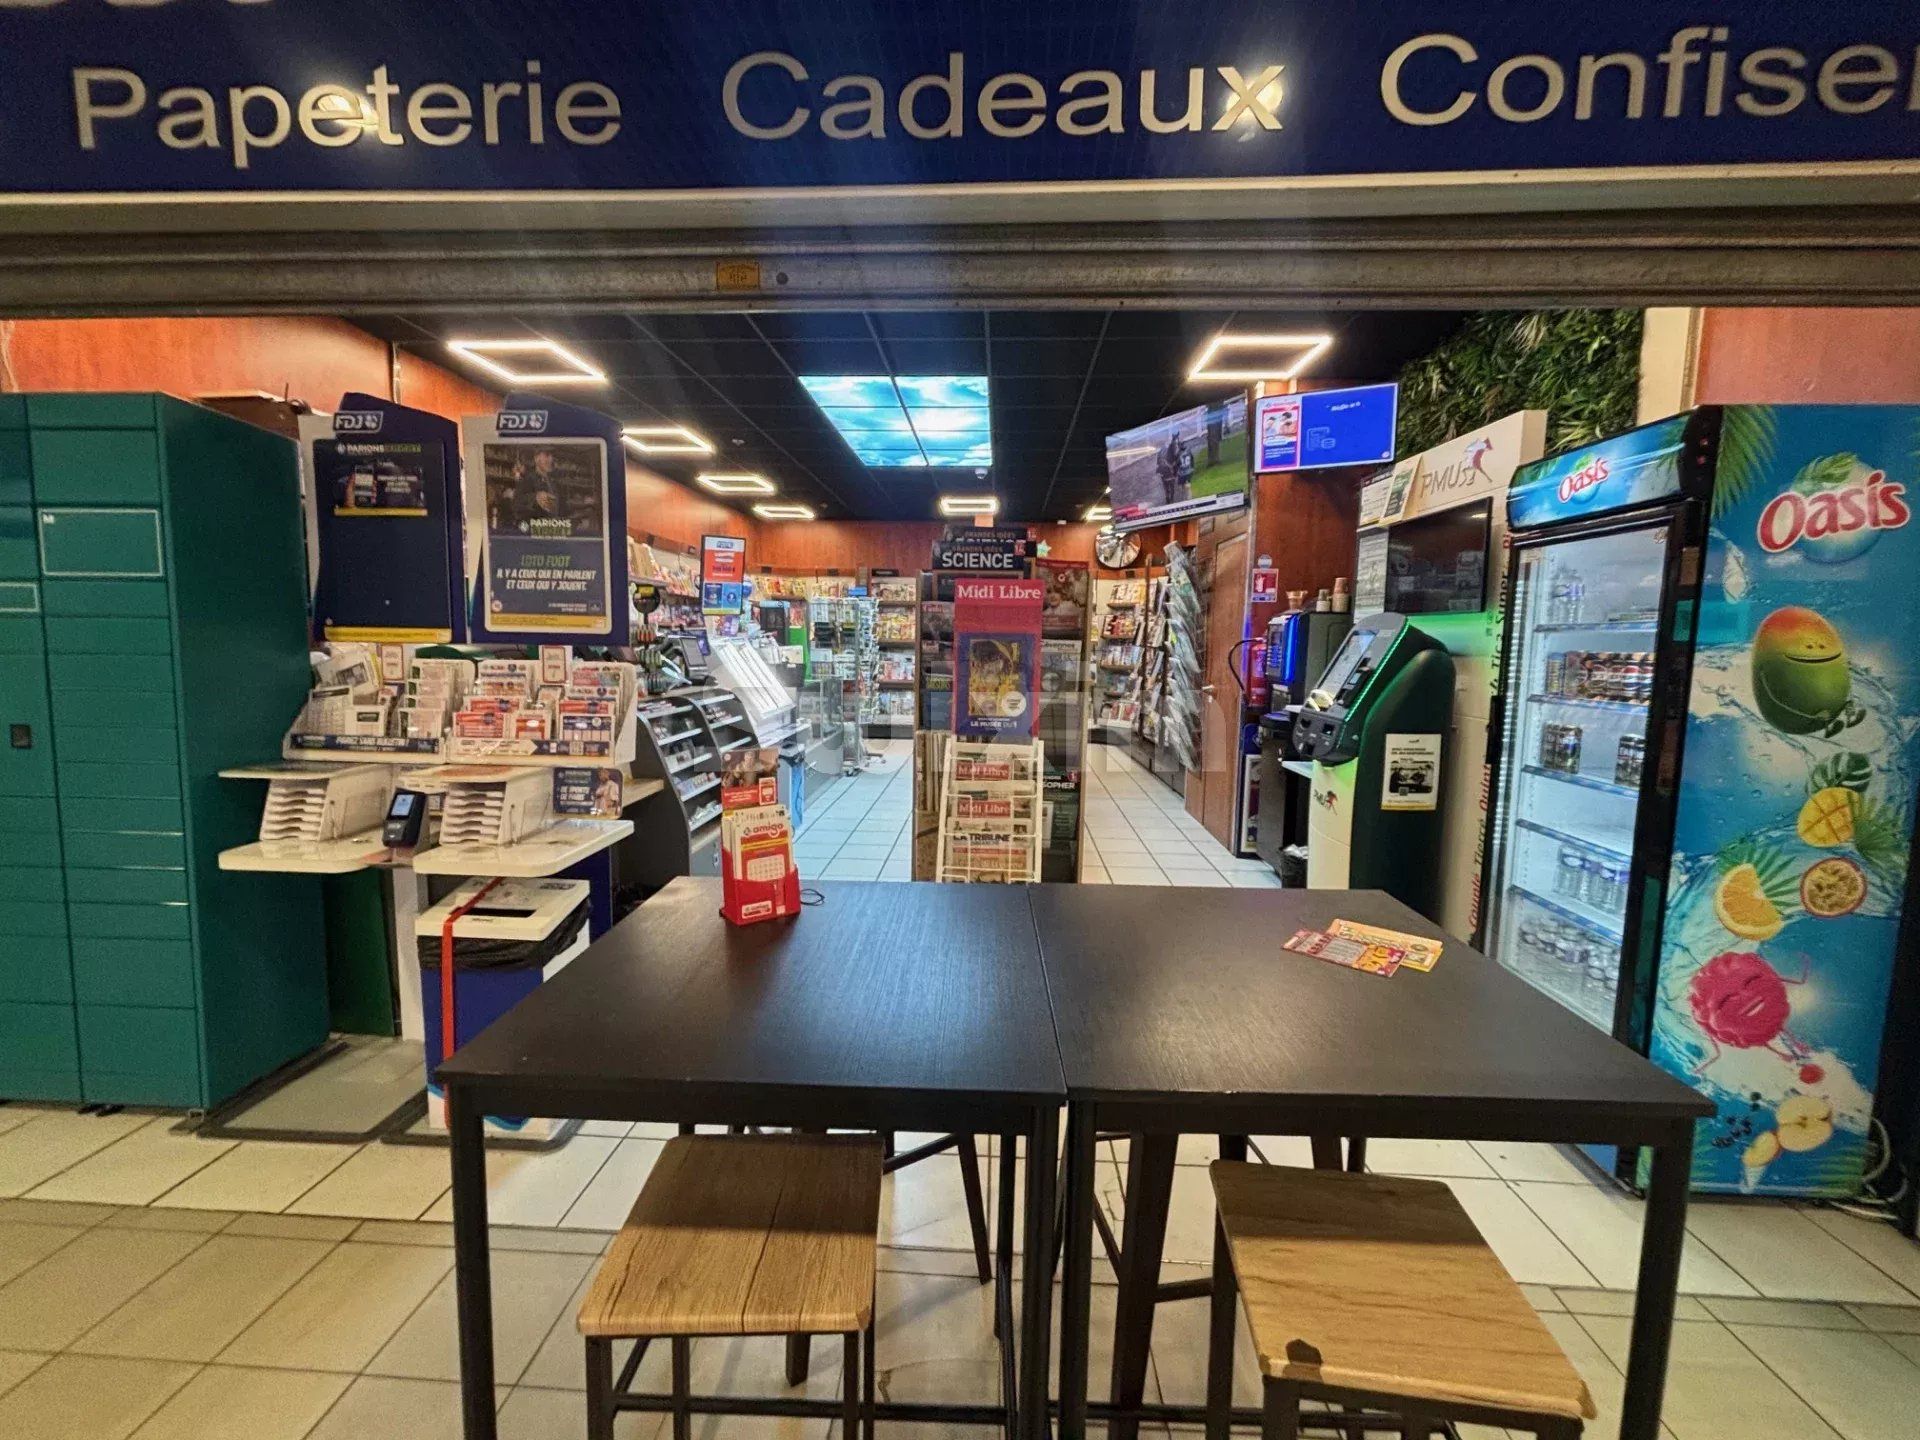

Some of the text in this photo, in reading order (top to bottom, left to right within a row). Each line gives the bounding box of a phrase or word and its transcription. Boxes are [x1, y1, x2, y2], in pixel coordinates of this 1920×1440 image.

[73, 60, 621, 168] Papeterie
[722, 50, 1286, 142] Cadeaux
[336, 414, 364, 429] FDJ
[500, 415, 528, 429] FDJ
[1559, 458, 1609, 503] Oasis
[1757, 470, 1910, 553] Oasis
[942, 553, 1013, 568] SCIENCE
[563, 570, 596, 580] PARLENT
[958, 584, 1041, 599] Midi Libre
[753, 822, 783, 836] amigo
